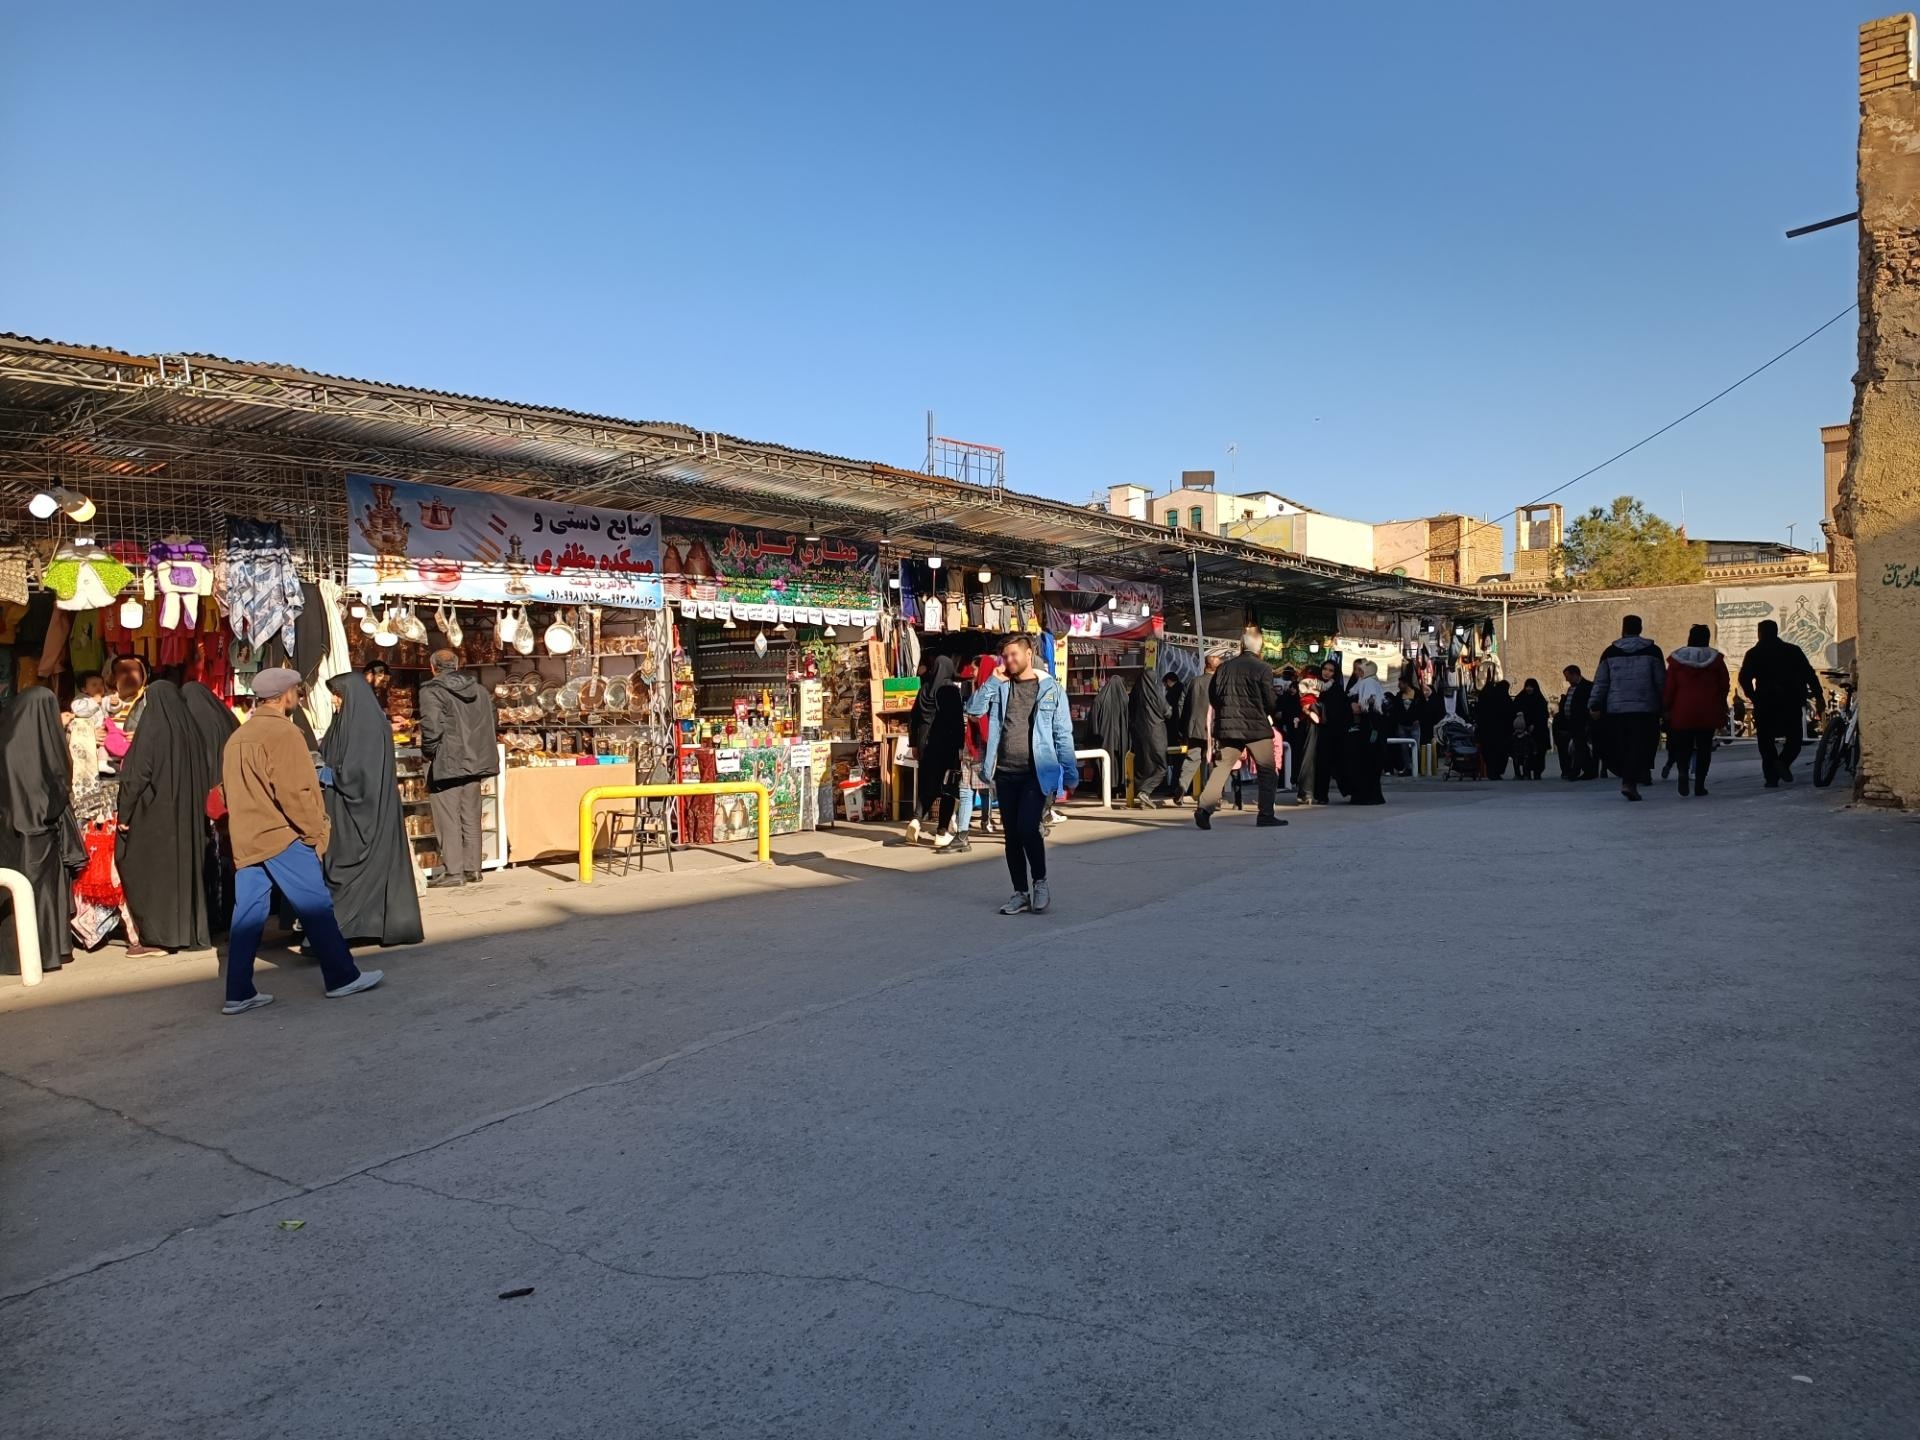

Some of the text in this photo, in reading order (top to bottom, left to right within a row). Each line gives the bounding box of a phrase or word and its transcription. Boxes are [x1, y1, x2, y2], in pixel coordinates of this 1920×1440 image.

[532, 510, 652, 541] صنایع دستی و
[533, 542, 596, 576] مظفری
[568, 577, 592, 588] قیمت
